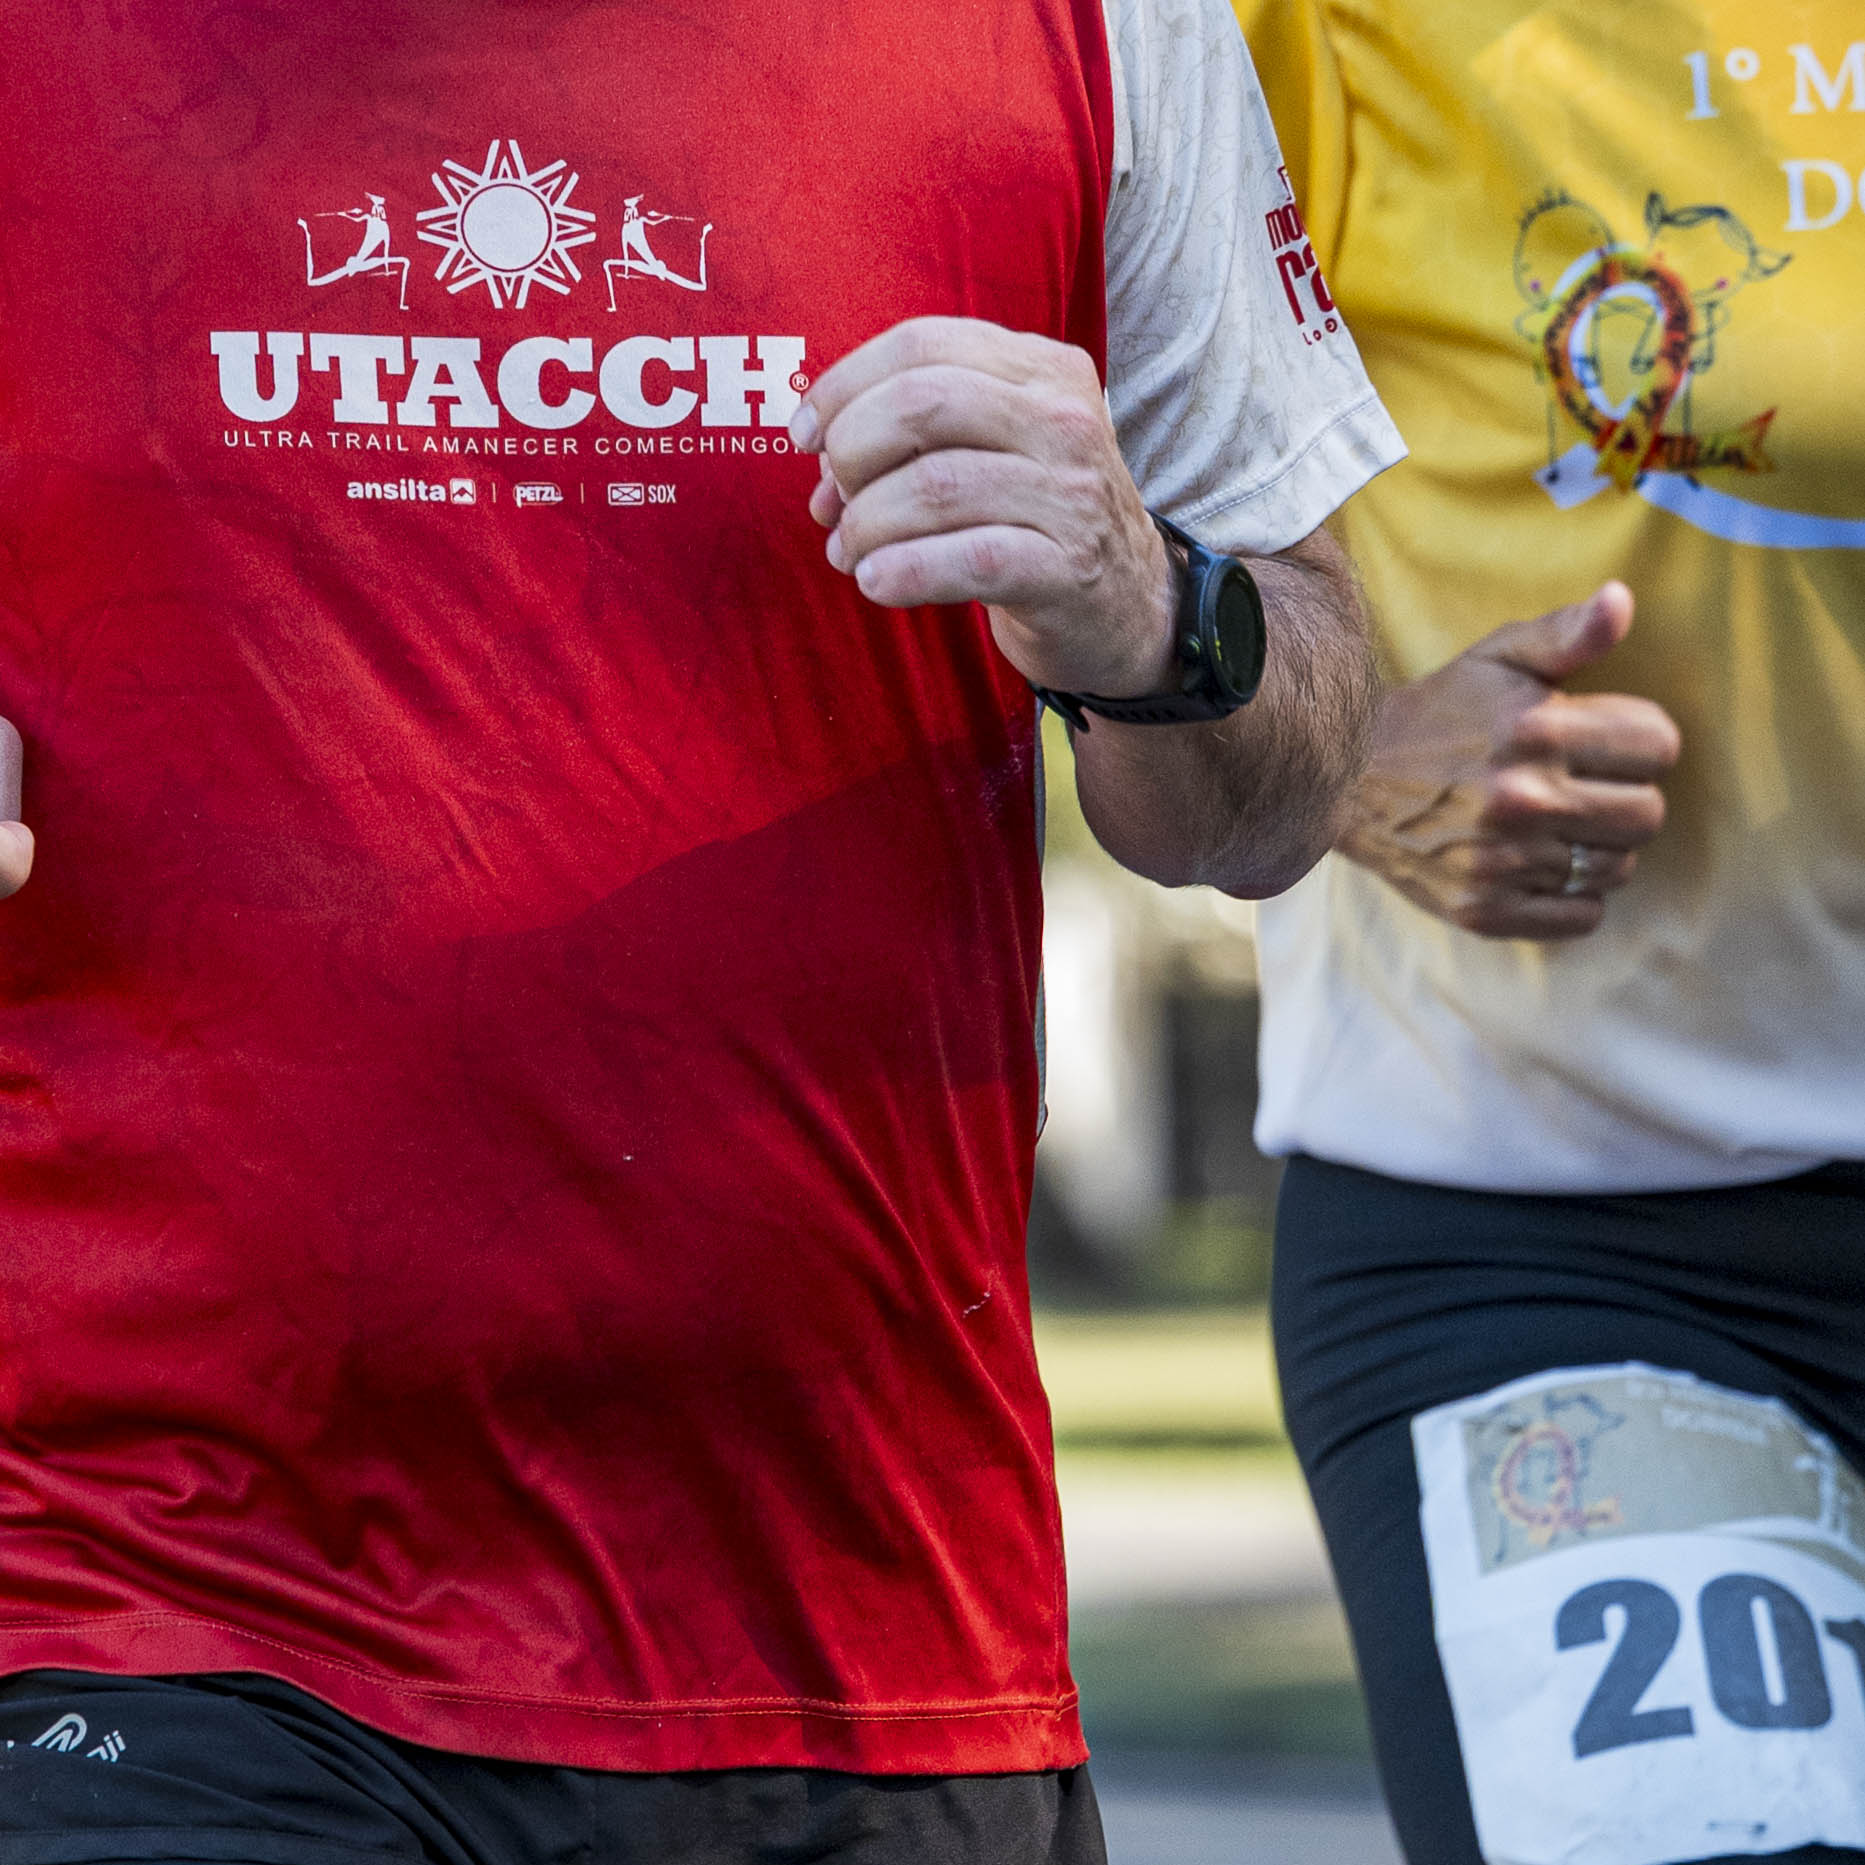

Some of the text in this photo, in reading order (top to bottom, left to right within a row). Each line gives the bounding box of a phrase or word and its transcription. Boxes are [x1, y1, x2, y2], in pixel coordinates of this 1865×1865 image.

[1779, 157, 1865, 232] D
[210, 332, 806, 428] UTACCH
[223, 431, 800, 455] ULTRA TRAIL AMANECER COMECHINGO
[346, 478, 677, 509] ansilta PETZL SOX
[1555, 1572, 1865, 1761] 20
